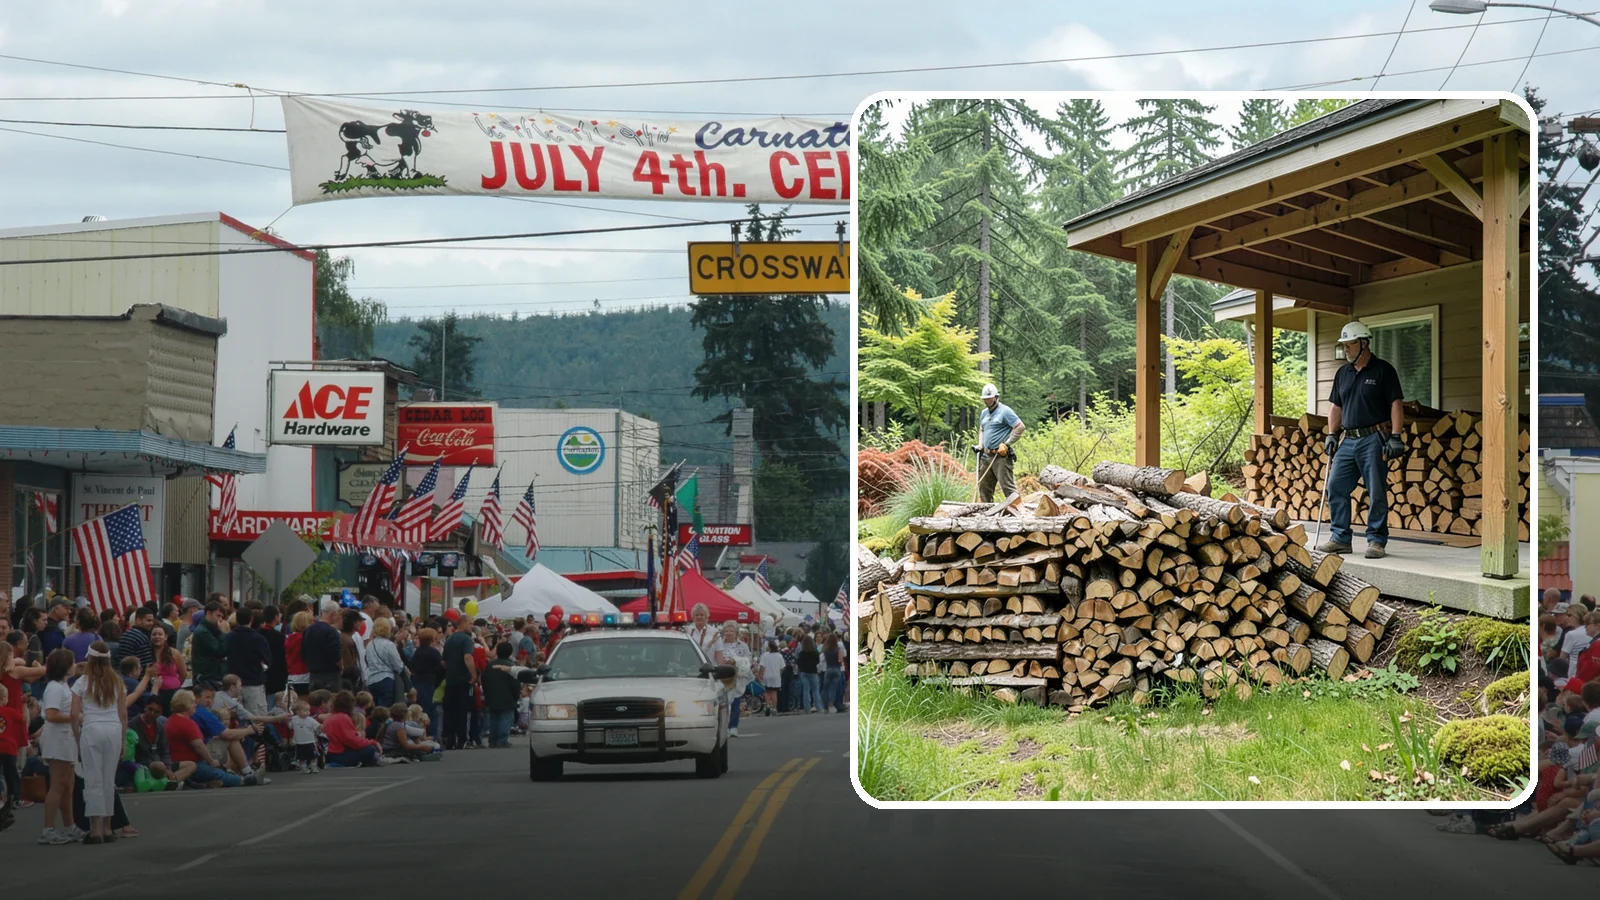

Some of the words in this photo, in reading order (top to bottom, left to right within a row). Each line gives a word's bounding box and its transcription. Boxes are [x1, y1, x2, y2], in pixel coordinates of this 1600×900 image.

[481, 141, 605, 192] JULY
[632, 150, 746, 197] 4th.
[697, 254, 850, 279] CROSSWA
[283, 380, 373, 420] ACE
[405, 409, 452, 422] CEDAR
[460, 409, 485, 422] LOG
[283, 421, 370, 436] Hardware
[416, 428, 477, 447] Coca-Cola
[353, 467, 385, 480] Simpl
[83, 485, 93, 494] St.
[95, 485, 124, 494] Vincent
[126, 486, 136, 495] de
[137, 486, 155, 495] Paul
[688, 526, 741, 535] CRNATION
[699, 535, 730, 543] GLASS
